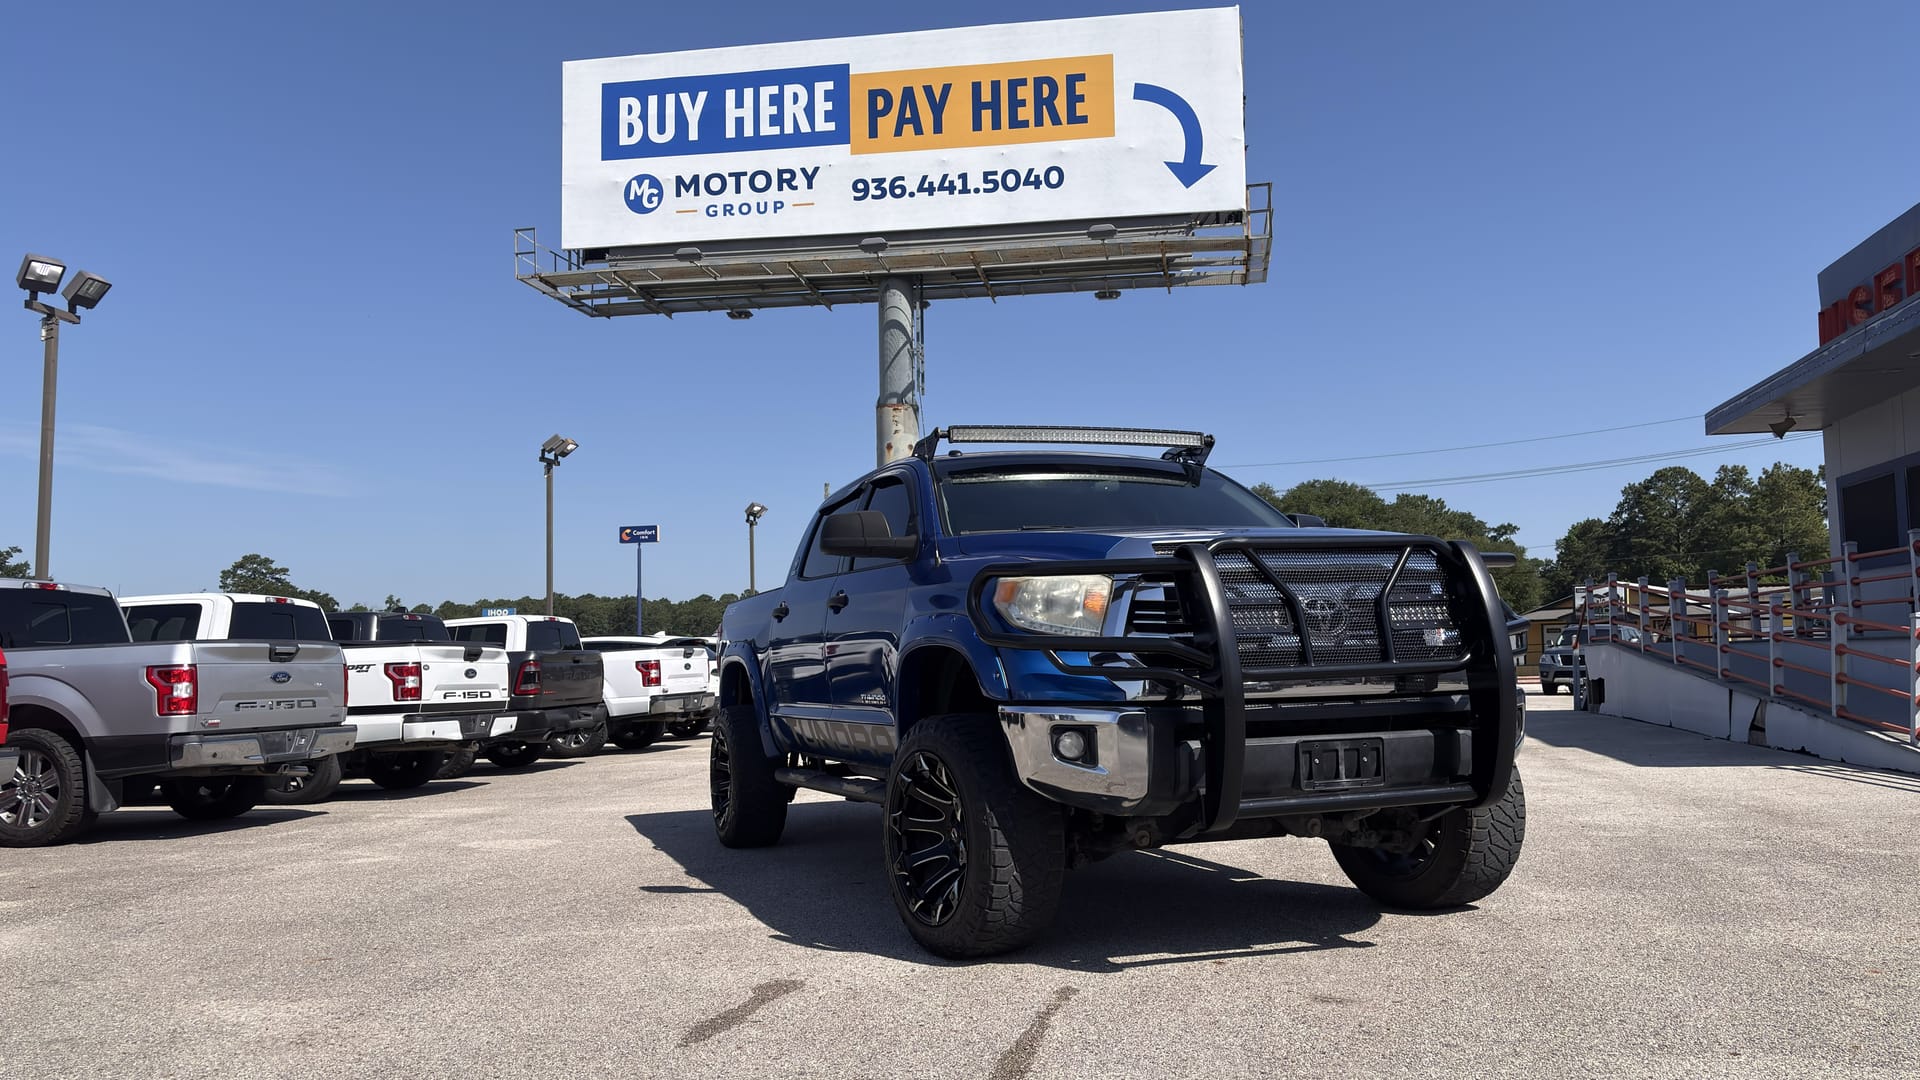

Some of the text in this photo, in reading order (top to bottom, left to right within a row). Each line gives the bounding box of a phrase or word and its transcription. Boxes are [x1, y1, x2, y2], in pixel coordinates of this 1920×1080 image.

[618, 72, 1089, 147] BUY HERE PAY HERE
[629, 179, 659, 209] MG
[675, 166, 820, 198] MOTORY
[851, 165, 1066, 201] 936.441.5040
[705, 200, 785, 217] GROUP
[1818, 246, 1920, 347] USE
[347, 663, 377, 671] ORT
[235, 699, 317, 712] F-150
[443, 691, 492, 699] F-150
